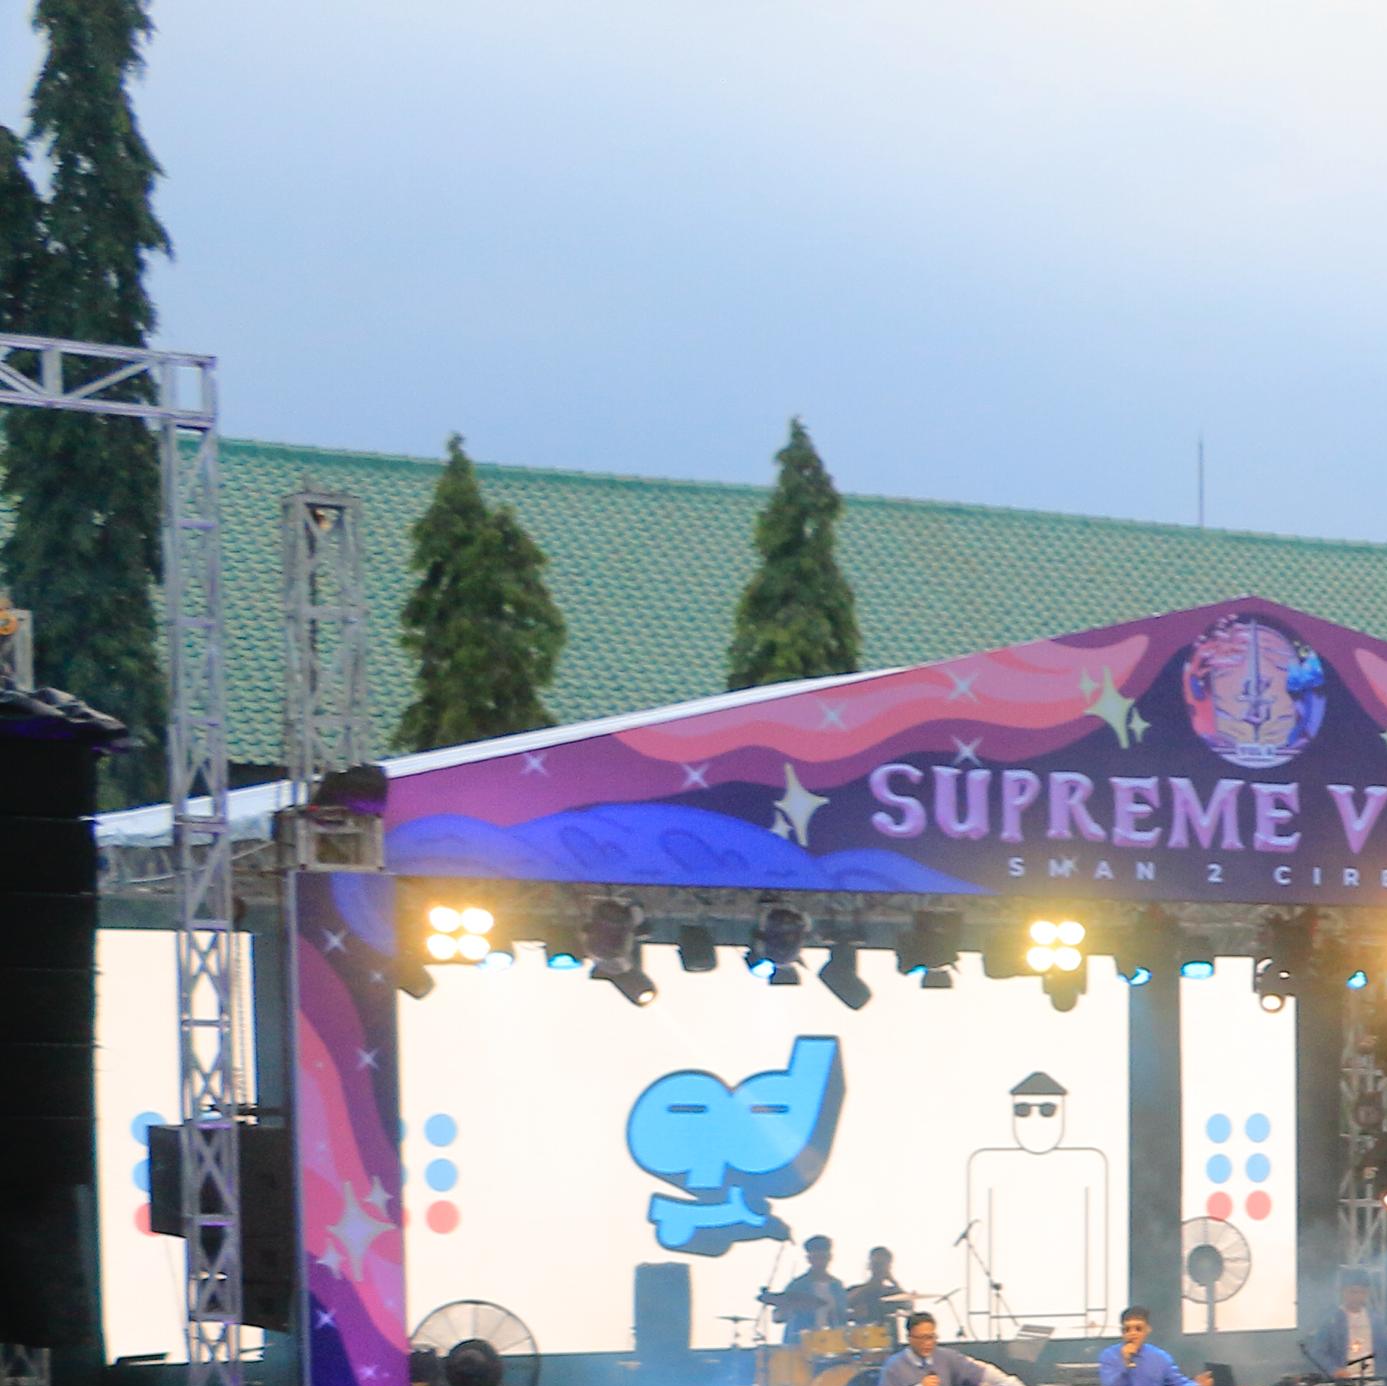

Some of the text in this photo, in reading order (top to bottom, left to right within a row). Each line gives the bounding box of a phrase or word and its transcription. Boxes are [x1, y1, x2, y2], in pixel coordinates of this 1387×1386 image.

[869, 763, 1300, 853] SUPREME
[1007, 855, 1156, 881] SMAN
[1207, 863, 1224, 883] 2
